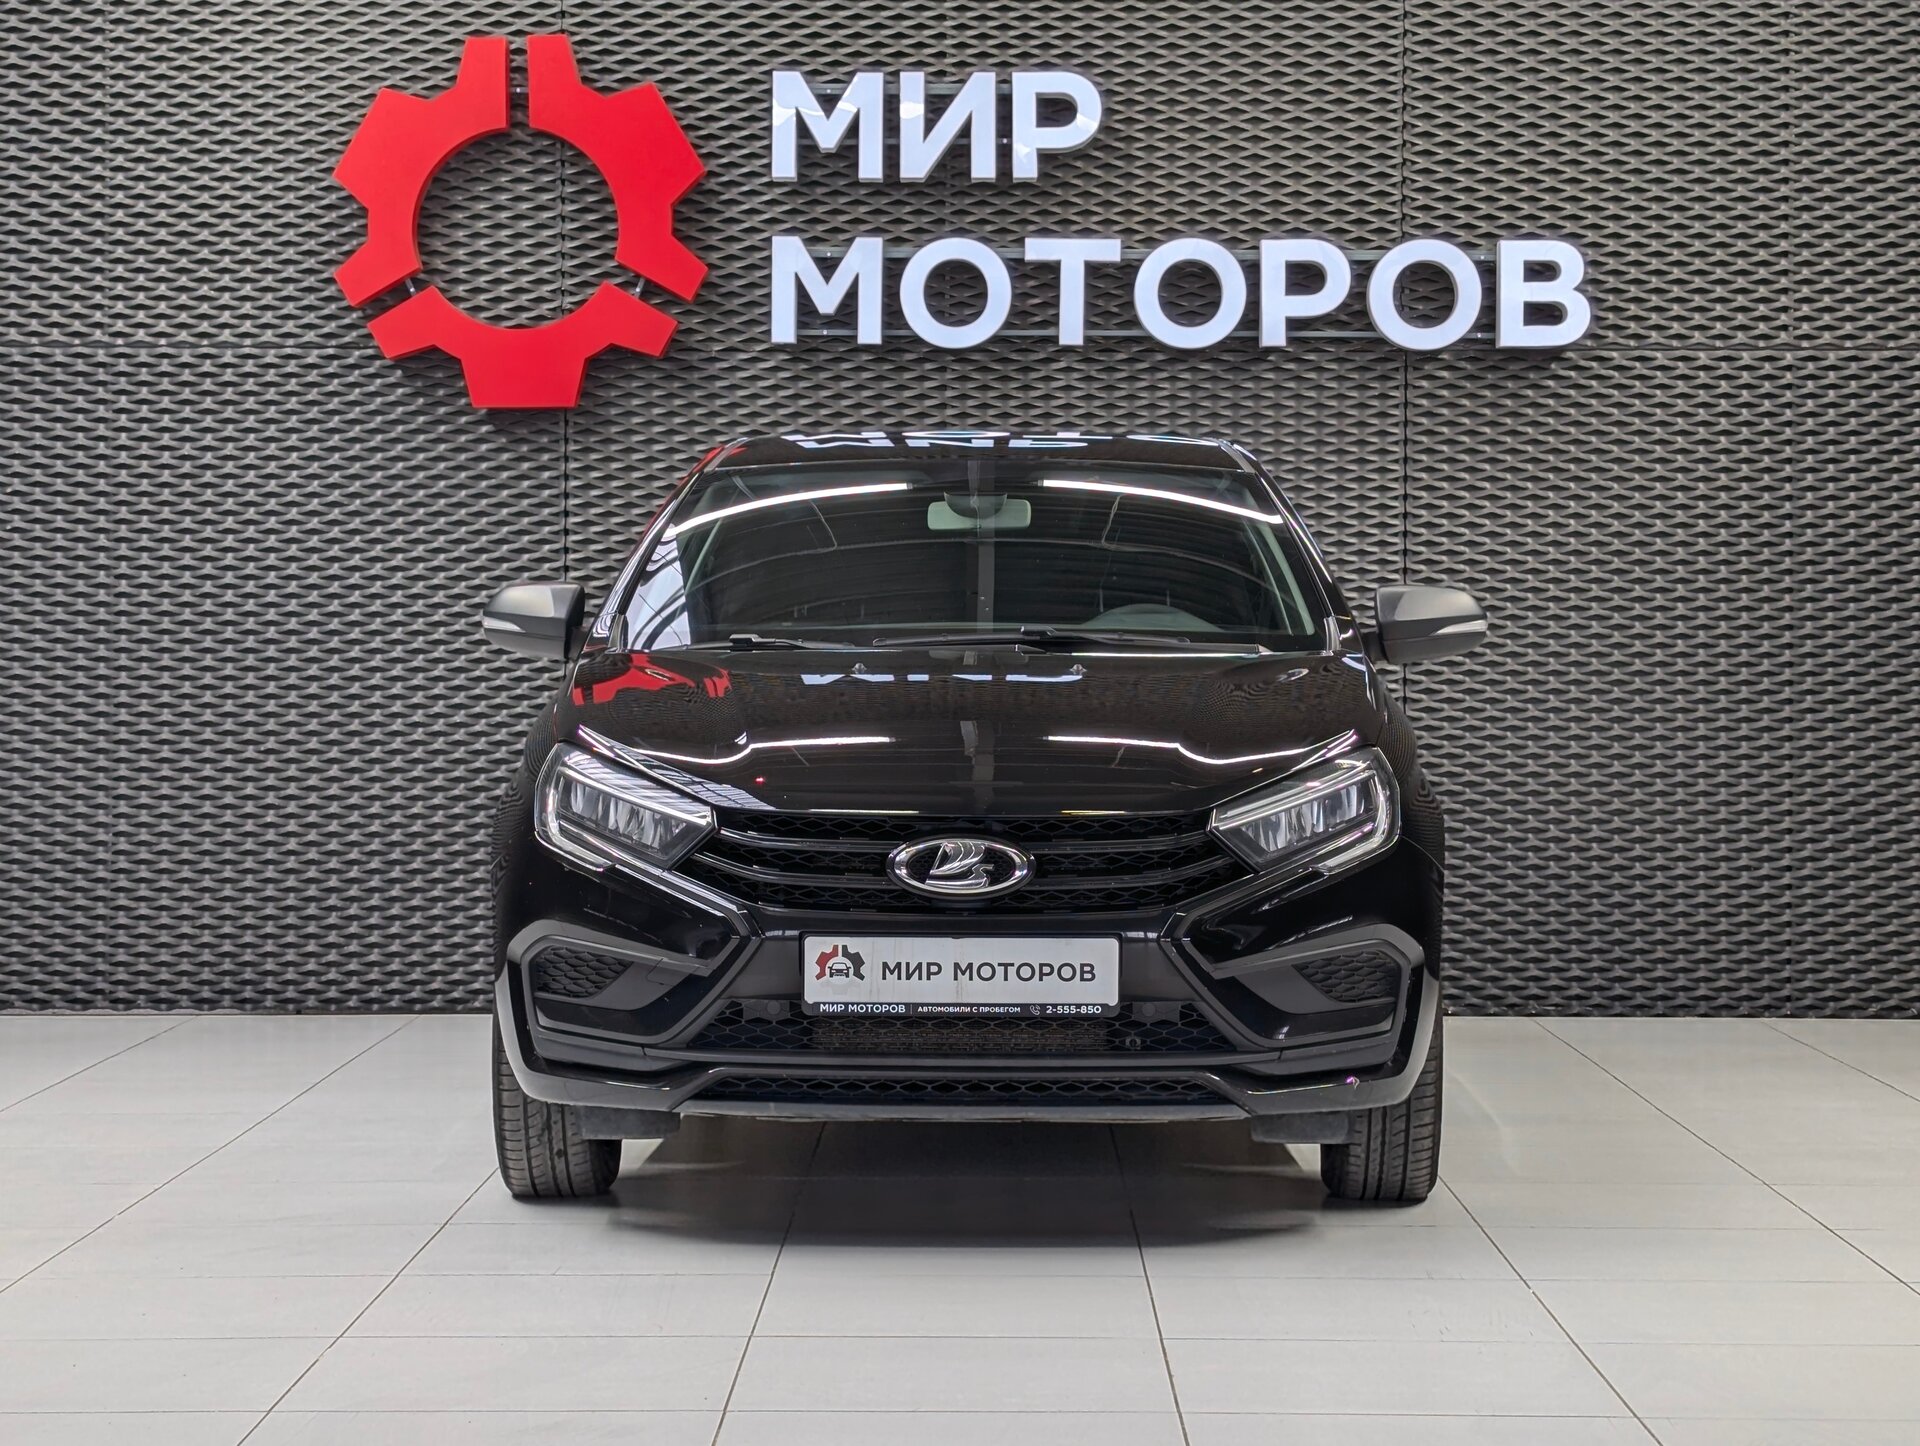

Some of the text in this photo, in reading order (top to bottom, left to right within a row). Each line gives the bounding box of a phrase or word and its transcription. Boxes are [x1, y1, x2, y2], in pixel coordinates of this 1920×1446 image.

[771, 70, 1104, 184] МИР
[770, 235, 1593, 351] МОТОРОВ
[881, 961, 1097, 982] МИР МОТОРОВ
[819, 1003, 845, 1013] МИР
[848, 1003, 907, 1013] МОТОРОВ
[979, 1006, 1021, 1014] ПРОБЕГОМ
[1046, 1005, 1102, 1014] 2-555-850
